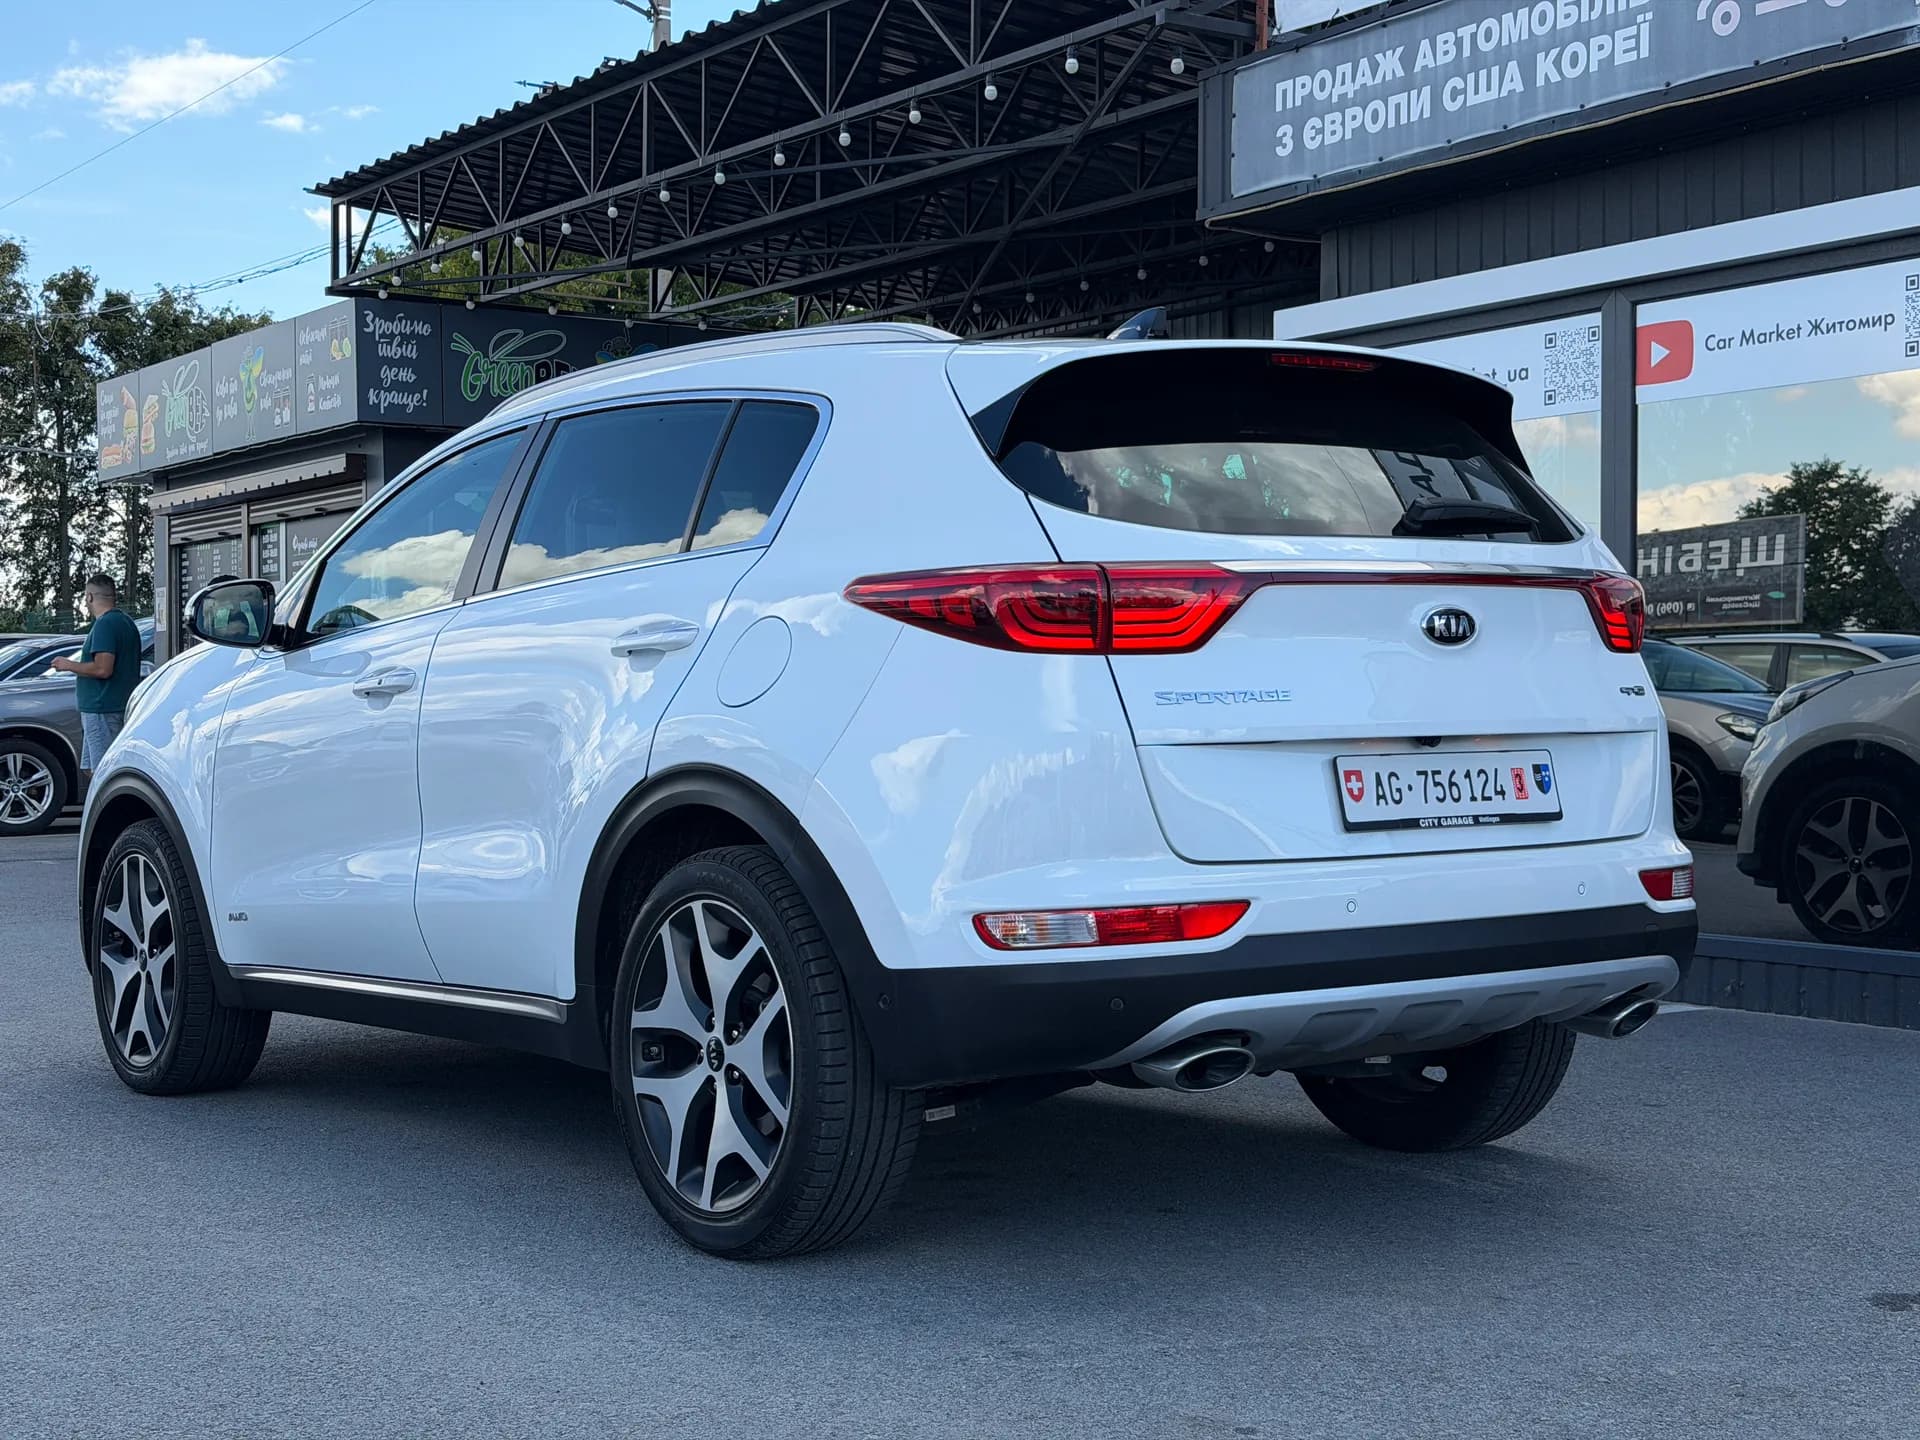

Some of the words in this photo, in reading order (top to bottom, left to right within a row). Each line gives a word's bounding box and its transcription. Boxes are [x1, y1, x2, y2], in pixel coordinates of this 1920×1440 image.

[1275, 45, 1405, 112] ПРОДАЖ
[1414, 0, 1650, 72] АВТОМОБІЛ
[1275, 124, 1294, 157] З
[1303, 85, 1431, 150] ЄВРОПИ
[1443, 60, 1524, 112] США
[1536, 11, 1653, 88] КОРЕЇ
[363, 310, 432, 341] Зробимо
[1705, 334, 1735, 351] Car
[1739, 323, 1802, 347] Market
[1807, 312, 1896, 337] Житомир
[378, 335, 418, 359] твій
[380, 365, 417, 387] день
[368, 388, 428, 414] краще!
[1433, 614, 1470, 637] KIA
[1154, 689, 1292, 706] SPORTAGE
[1419, 818, 1438, 827] CITY
[1440, 816, 1475, 826] GARAGE
